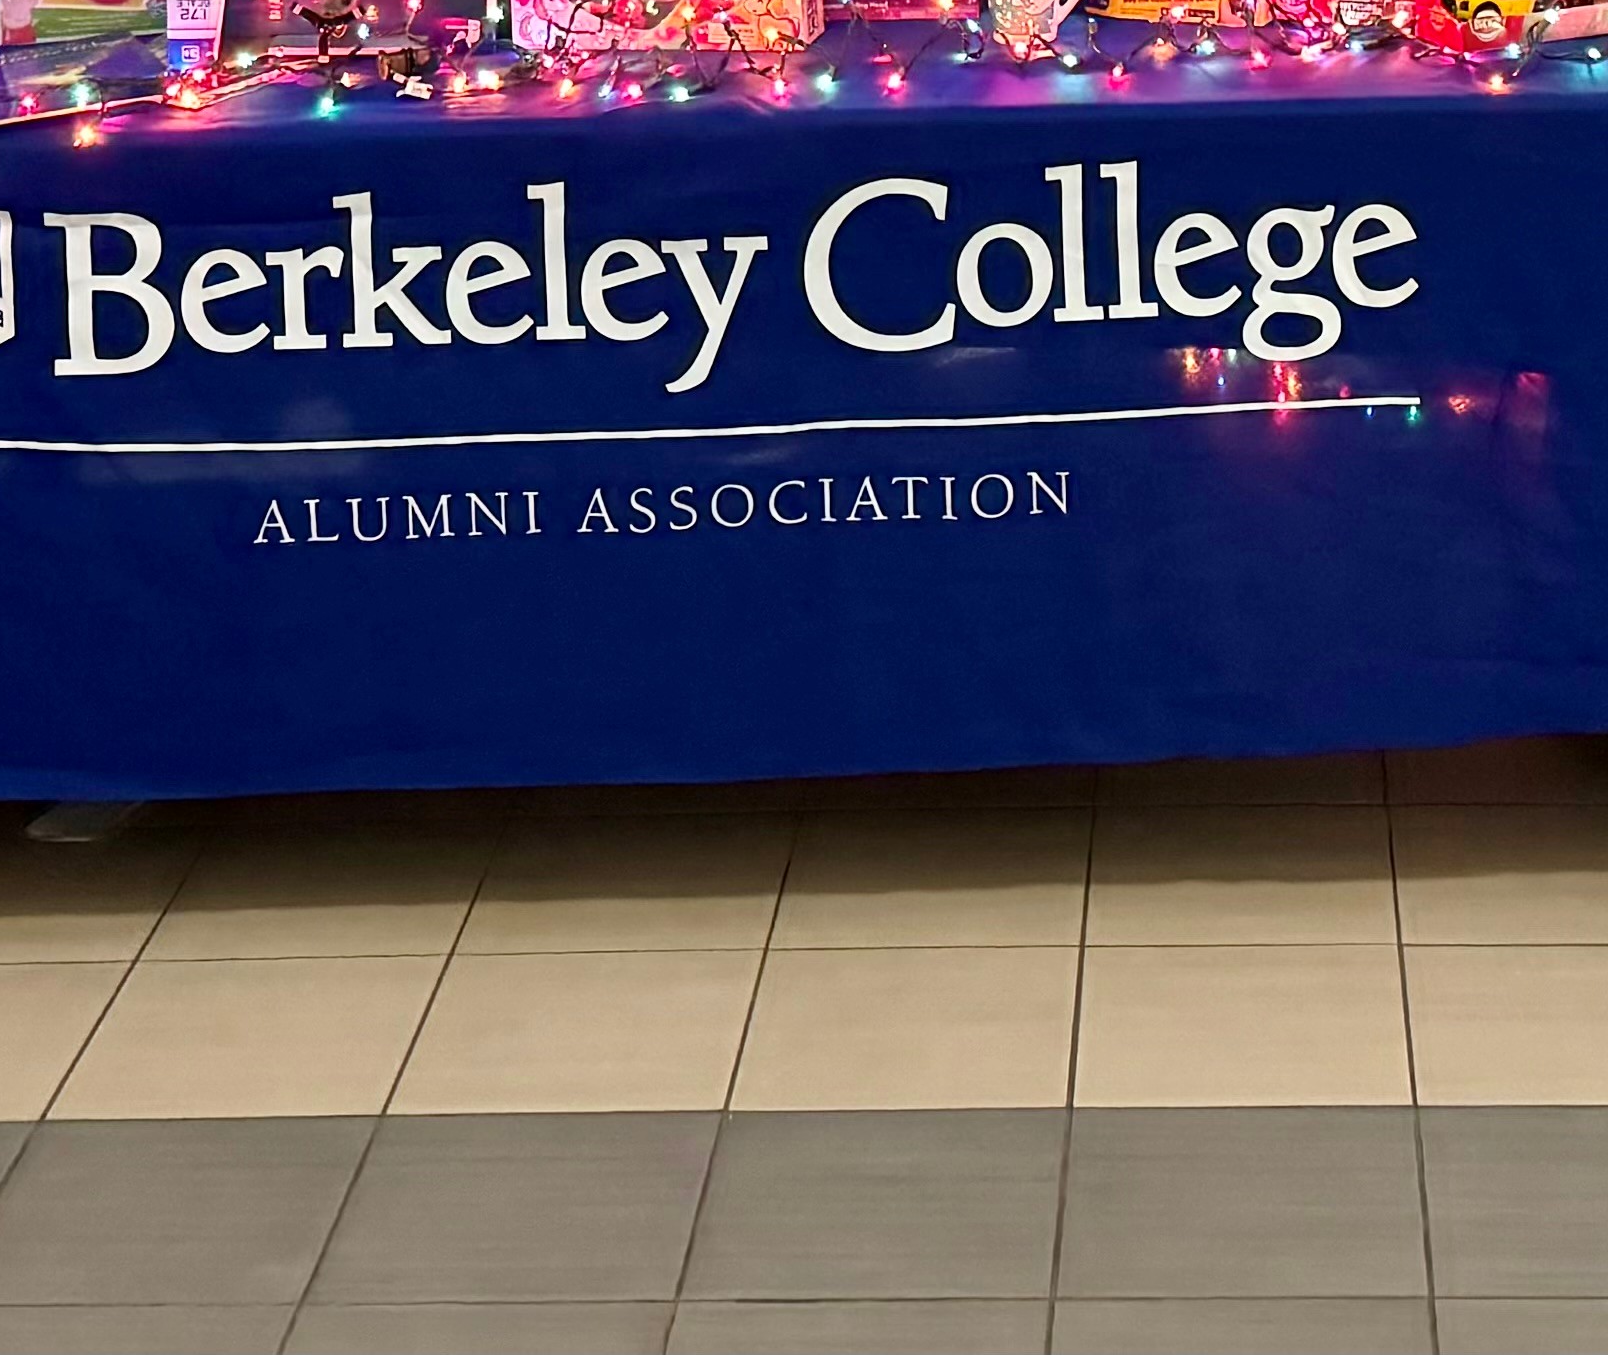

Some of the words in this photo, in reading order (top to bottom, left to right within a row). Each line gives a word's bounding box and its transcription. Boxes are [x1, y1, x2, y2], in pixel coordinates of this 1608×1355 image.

[44, 182, 769, 393] Berkeley
[804, 161, 1420, 362] College
[253, 491, 542, 544] ALUMNI
[577, 472, 1070, 534] ASSOCIATION
